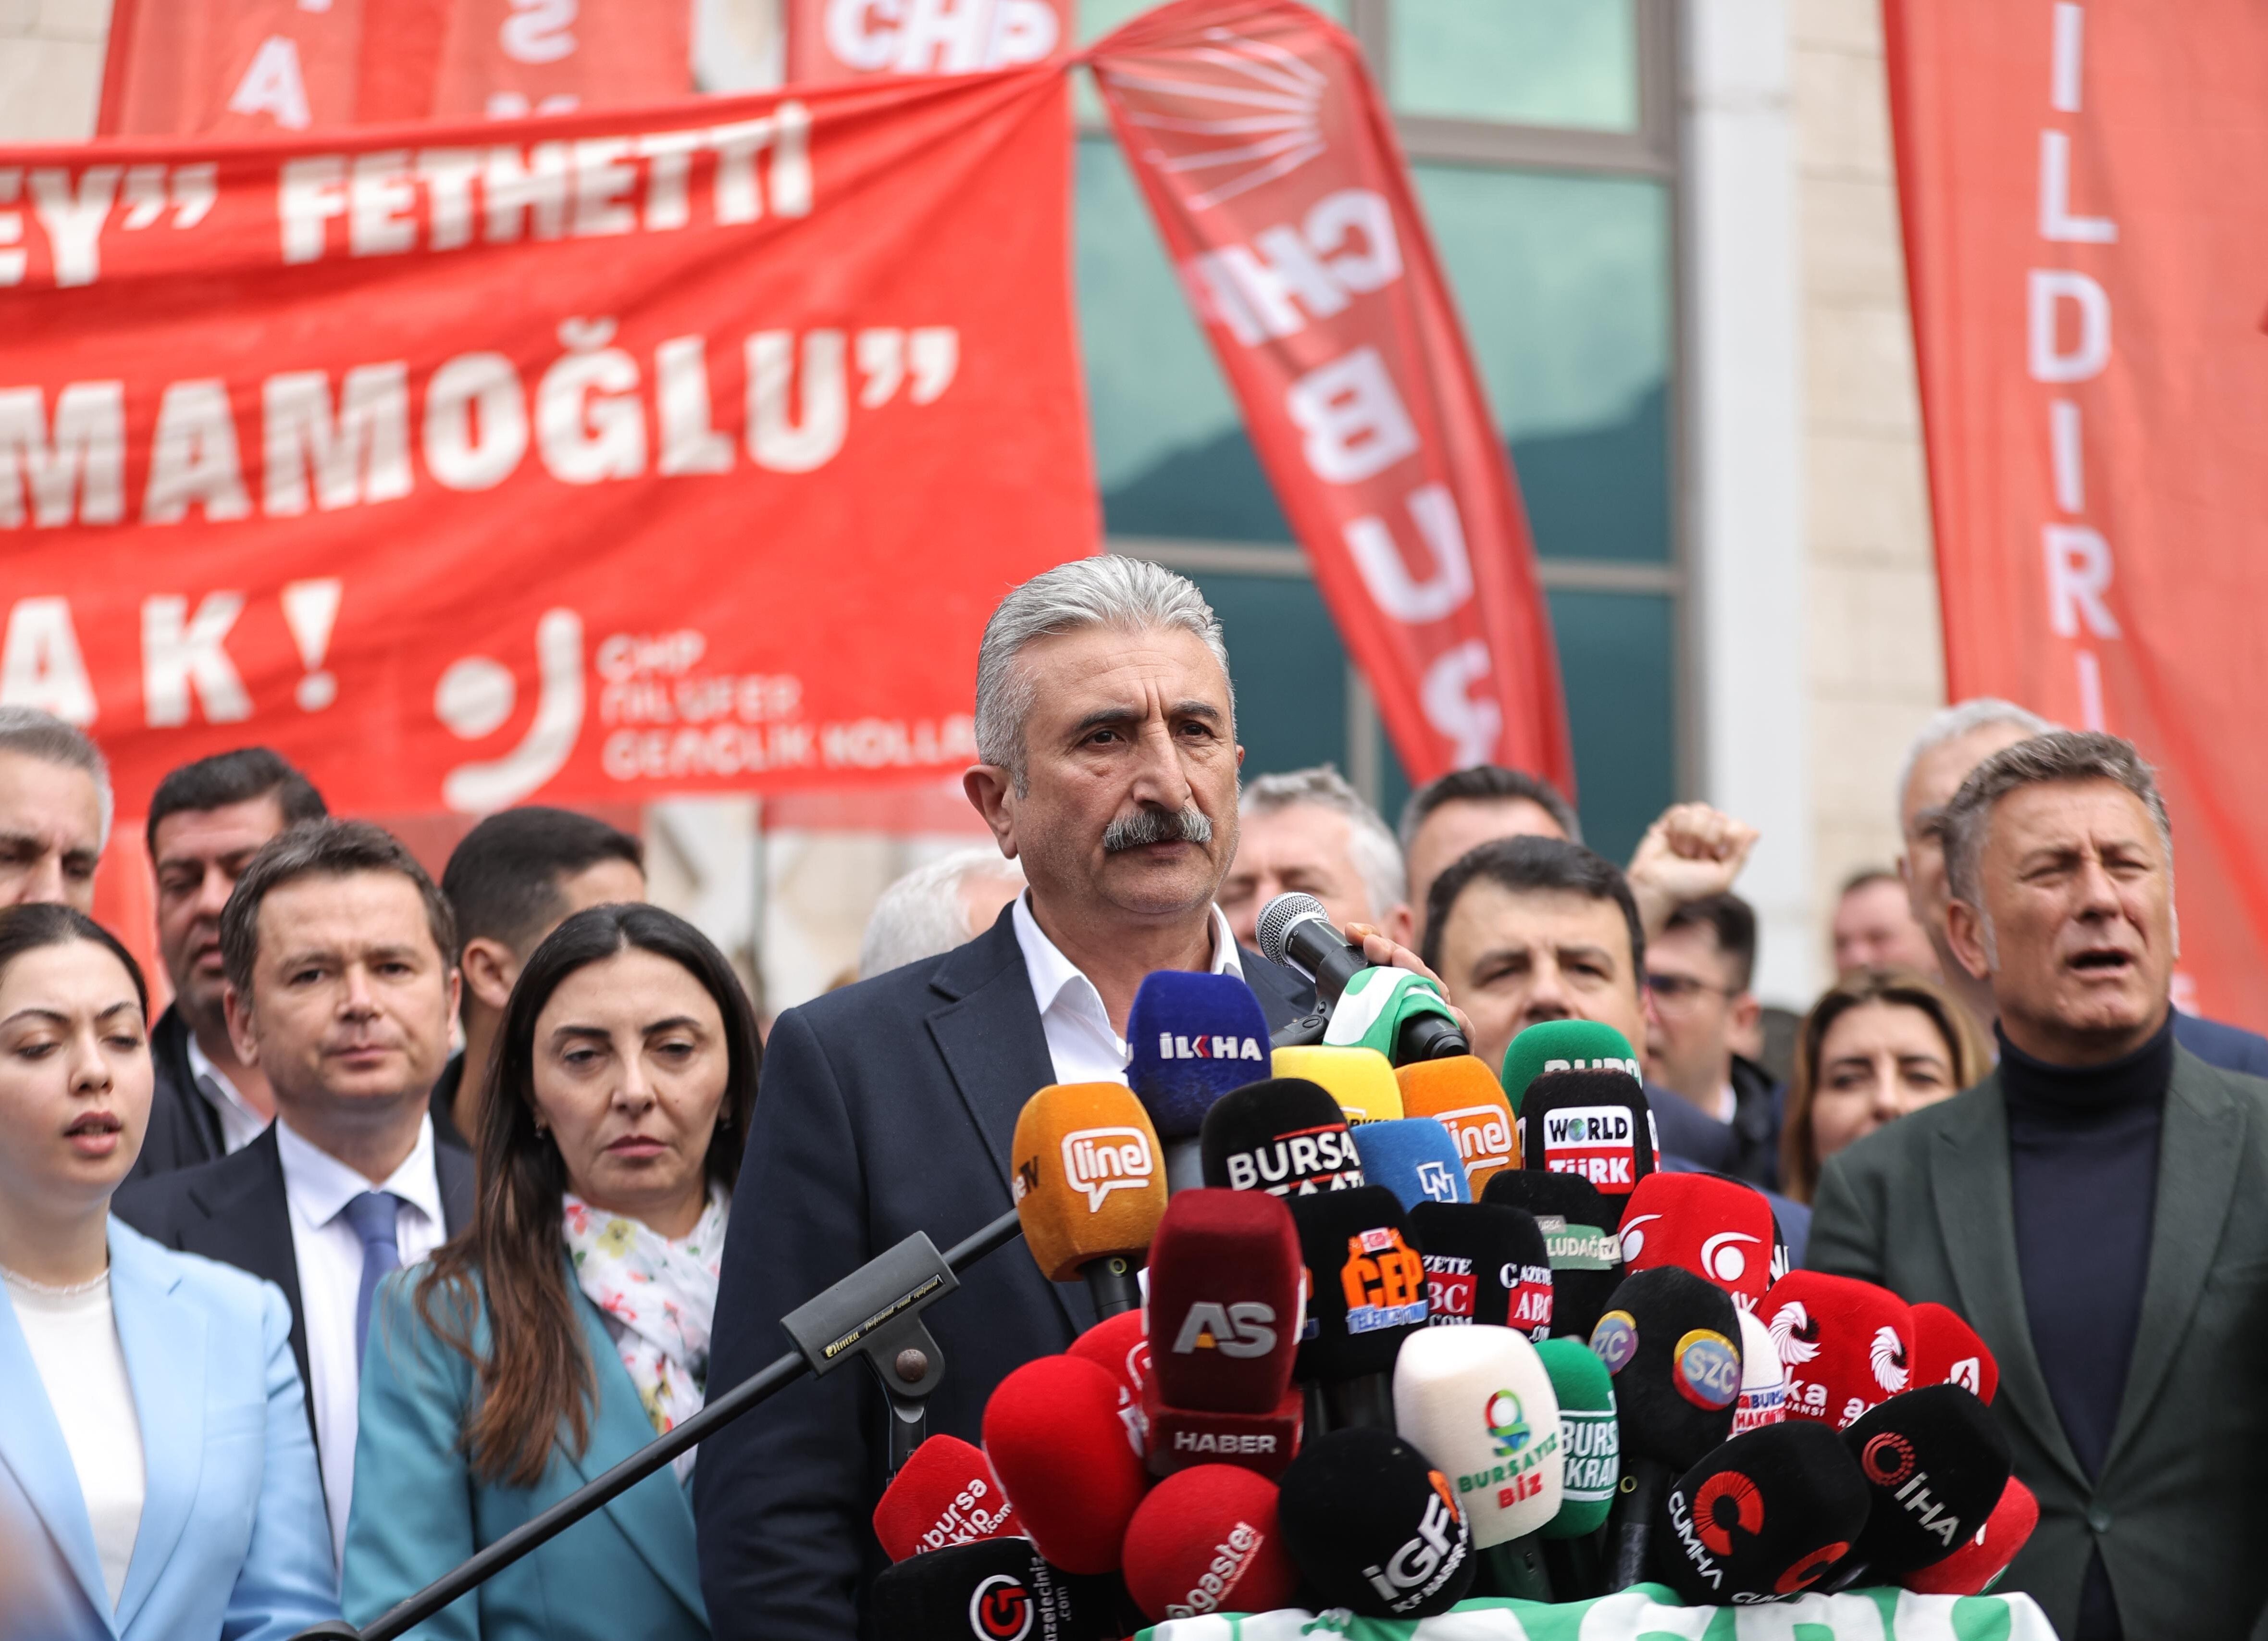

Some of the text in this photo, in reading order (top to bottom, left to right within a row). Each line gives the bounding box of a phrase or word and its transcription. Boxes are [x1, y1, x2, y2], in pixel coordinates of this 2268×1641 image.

[276, 100, 813, 265] FETHETTİ
[1159, 1032, 1263, 1061] İLKHA
[1442, 1120, 1514, 1159] ine
[1549, 1116, 1628, 1143] WORLD
[1226, 1131, 1362, 1192] BURSA
[1172, 1301, 1277, 1359] AS
[1688, 1347, 1736, 1394] SZC
[1174, 1431, 1277, 1455] HABER
[922, 1479, 988, 1548] bursa
